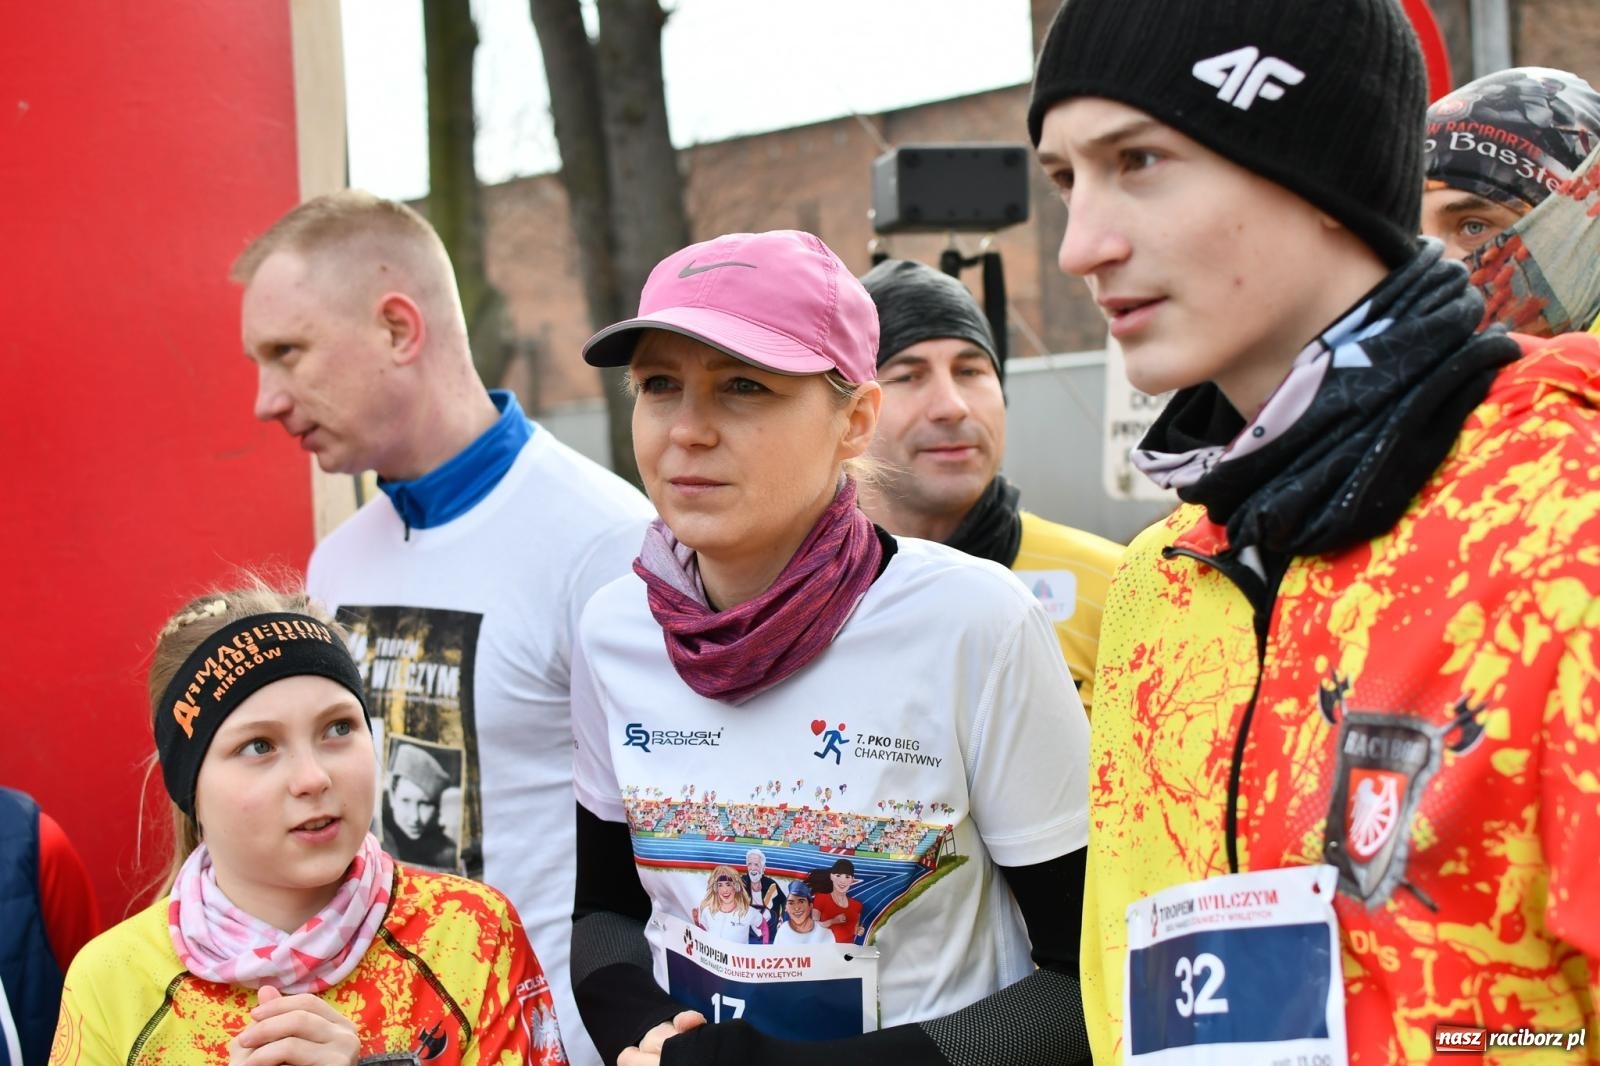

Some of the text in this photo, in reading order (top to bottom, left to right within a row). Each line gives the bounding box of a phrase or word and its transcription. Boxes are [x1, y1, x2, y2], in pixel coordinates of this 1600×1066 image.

[1192, 46, 1306, 111] 4F
[213, 641, 260, 681] KIDS
[213, 647, 282, 702] MIKOŁÓW
[651, 738, 720, 746] RADICAL
[652, 730, 721, 739] ROUGH
[856, 733, 920, 751] 7. PKO BIEG
[854, 747, 942, 768] CHARYTATYWNY
[1159, 899, 1195, 923] TROPEM
[1198, 890, 1280, 912] WILCZYM
[694, 939, 812, 970] TROPEM WILCZYM
[1174, 952, 1230, 1018] 32
[711, 992, 746, 1025] 17
